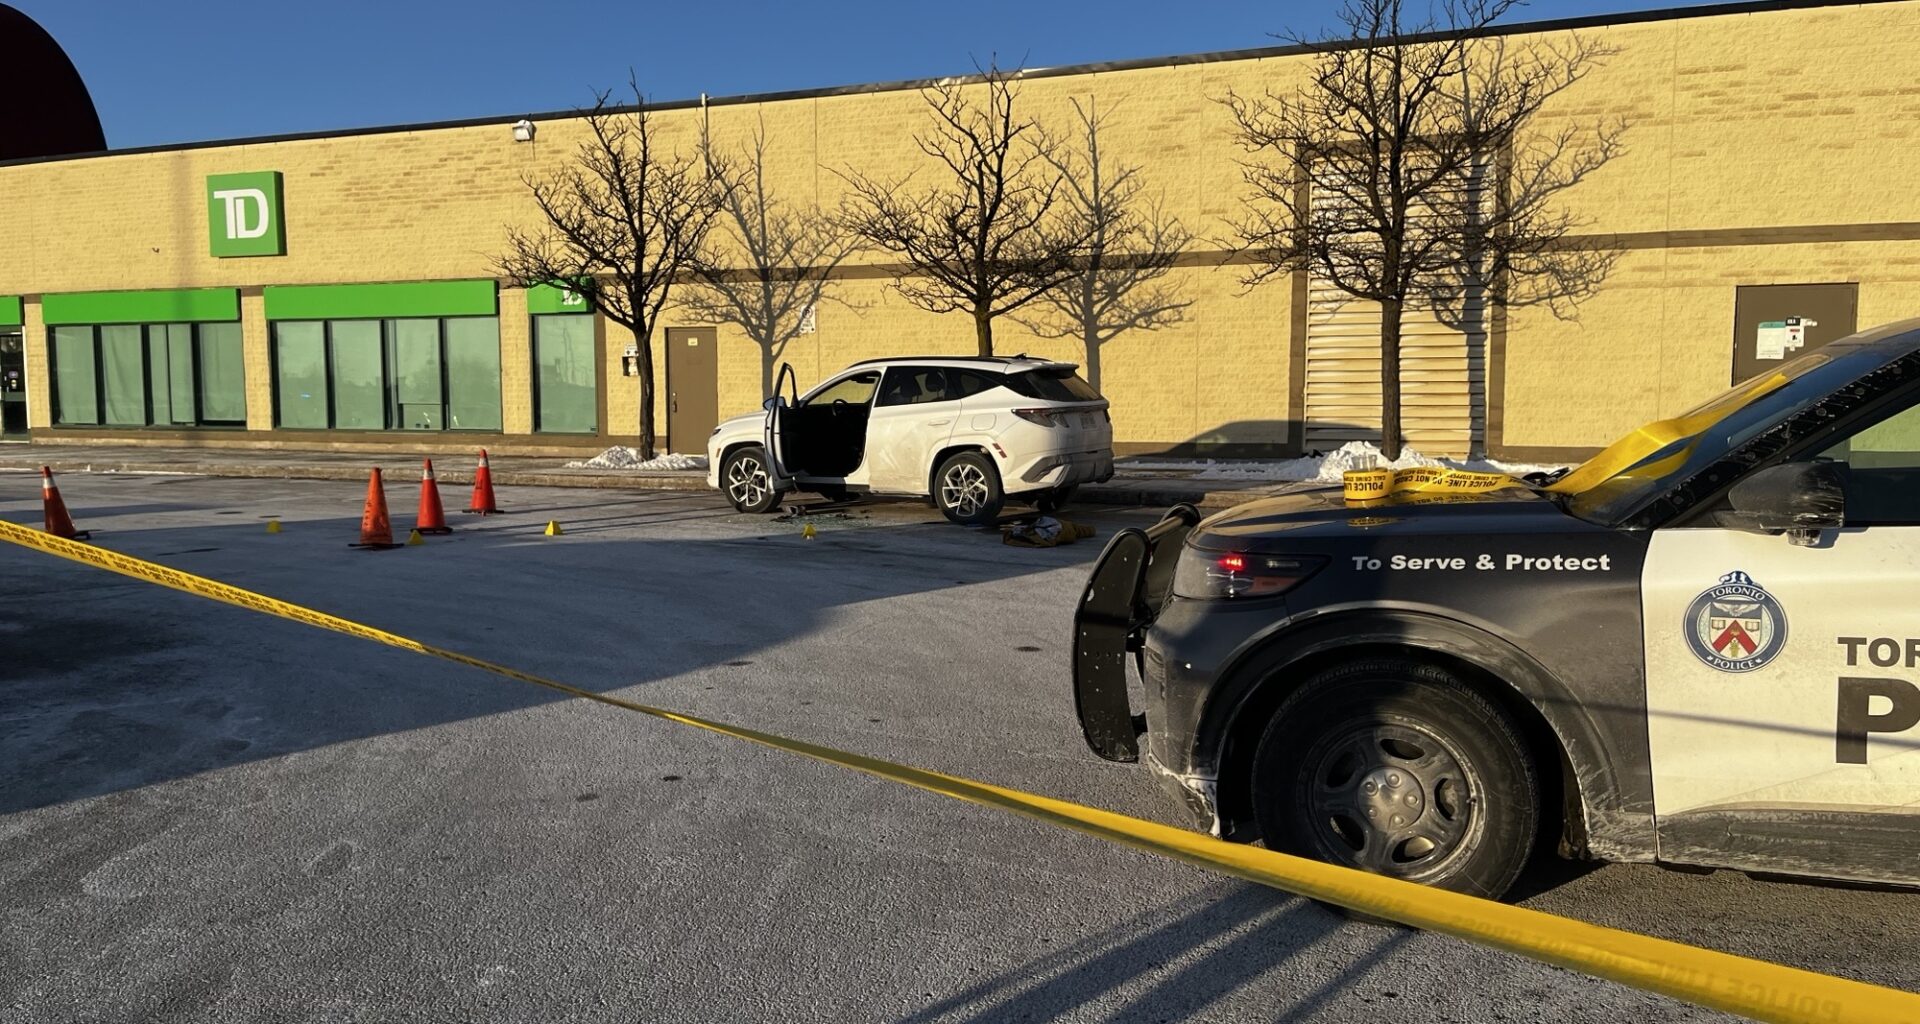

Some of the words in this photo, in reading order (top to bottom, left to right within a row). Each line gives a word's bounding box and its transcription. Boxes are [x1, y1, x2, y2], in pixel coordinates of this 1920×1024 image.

[213, 188, 269, 239] TD
[1354, 481, 1384, 491] POLICE
[1416, 475, 1431, 483] NOT
[1468, 480, 1498, 488] POLICE
[1352, 556, 1382, 571] To
[1390, 554, 1466, 571] Serve
[1475, 553, 1496, 570] &
[1505, 553, 1611, 571] Protect
[1710, 586, 1766, 602] TORONTO
[1713, 658, 1755, 671] POLICE
[1836, 676, 1920, 765] P
